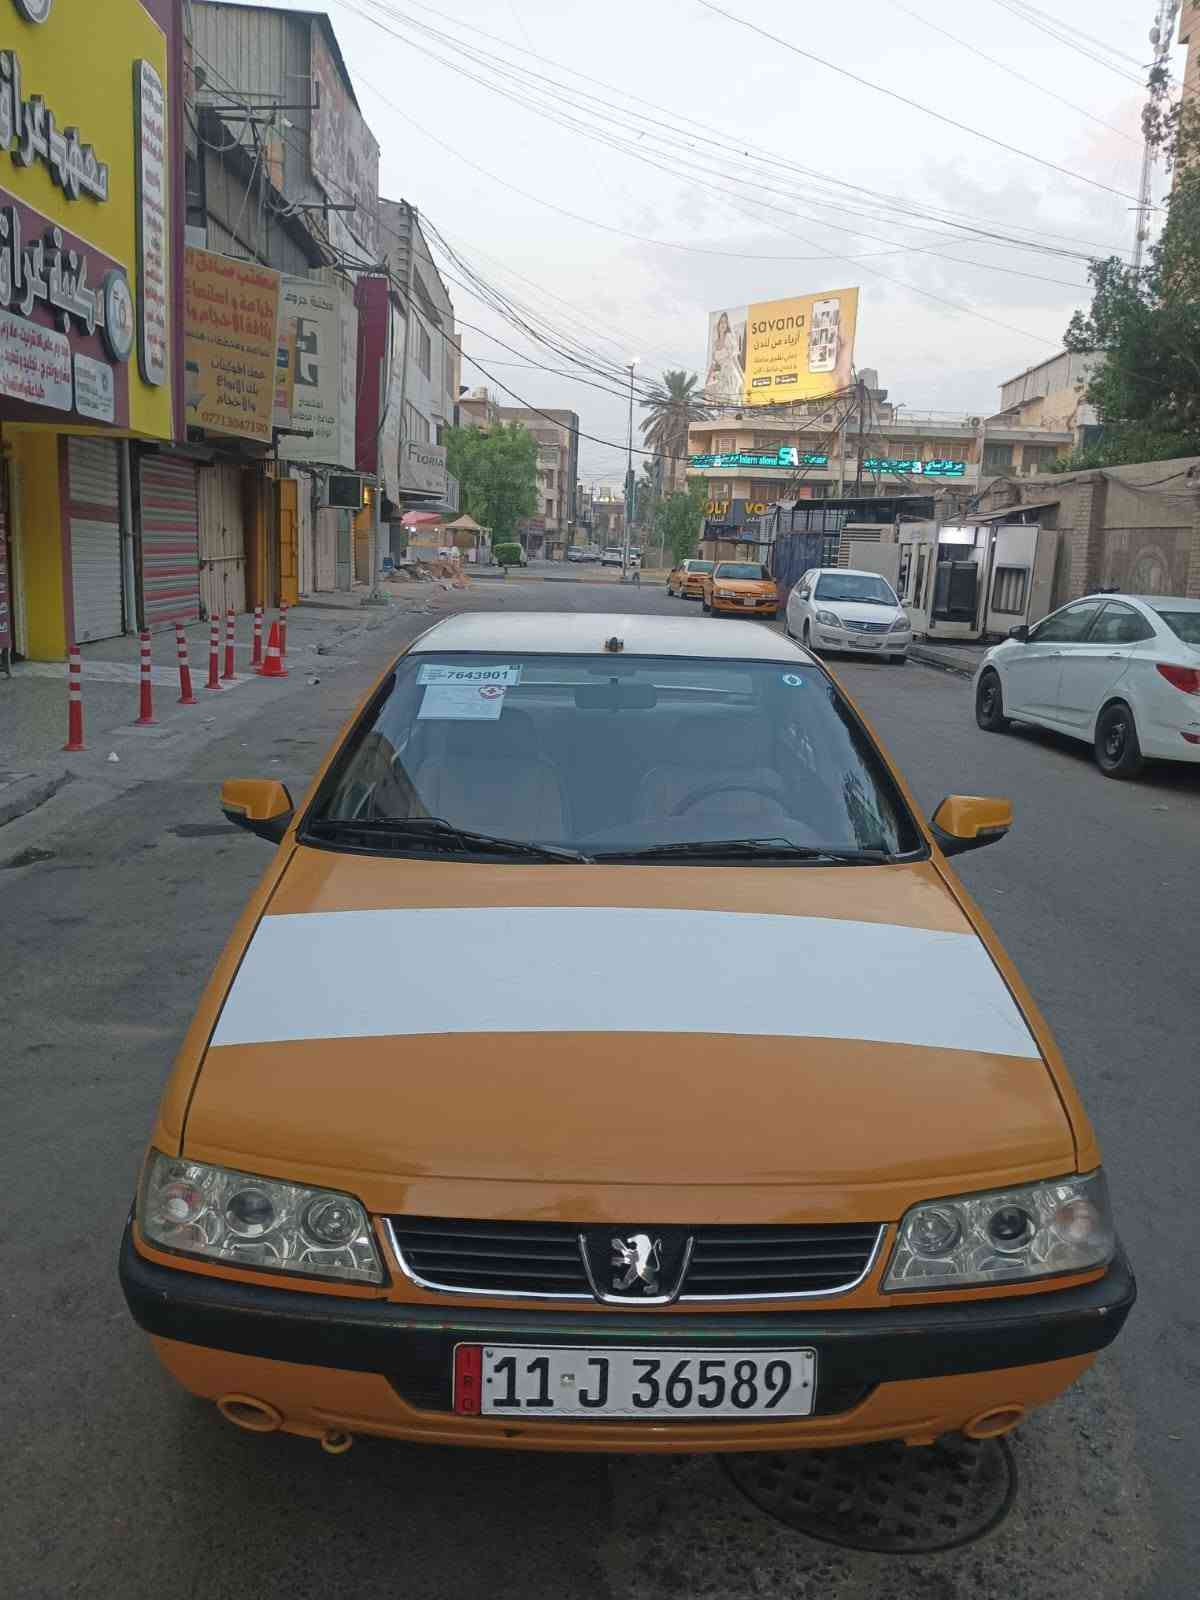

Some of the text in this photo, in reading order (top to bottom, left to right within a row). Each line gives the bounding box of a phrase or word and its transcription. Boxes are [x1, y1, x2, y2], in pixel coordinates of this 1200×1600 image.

[752, 315, 804, 334] savana
[447, 671, 508, 680] 7643901
[493, 1356, 792, 1409] 11 J 36589
